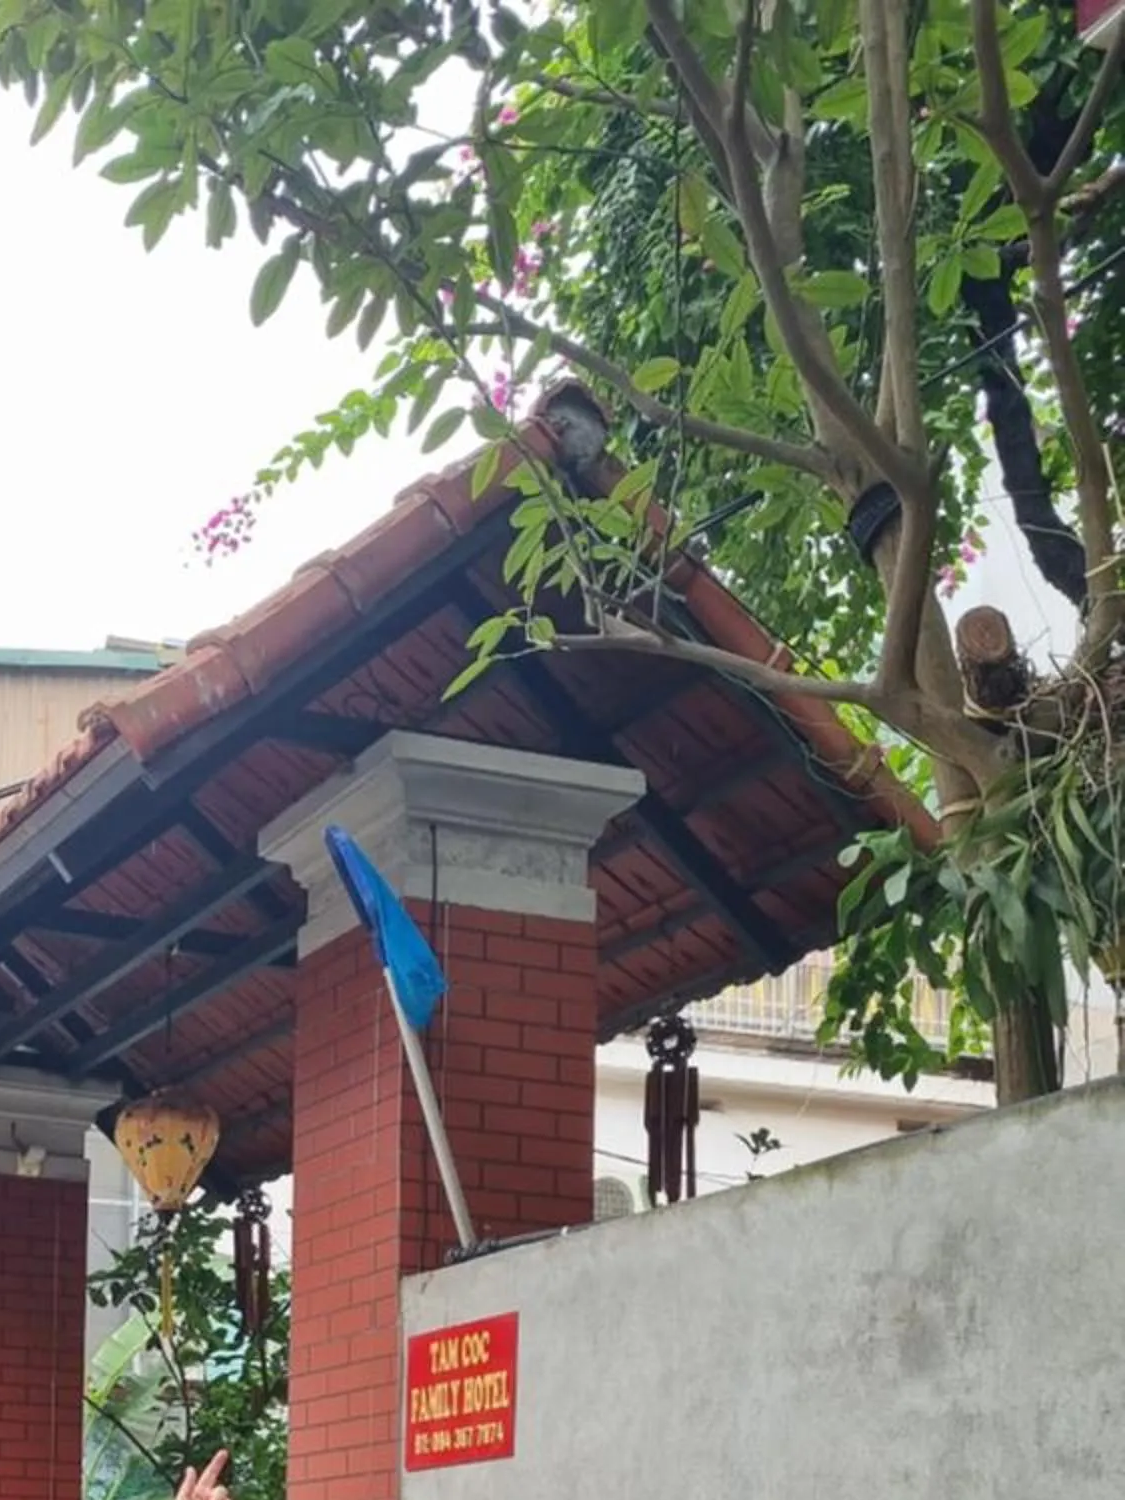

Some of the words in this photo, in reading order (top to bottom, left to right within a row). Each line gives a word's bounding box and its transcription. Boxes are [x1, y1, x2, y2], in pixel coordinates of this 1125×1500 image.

[430, 1336, 459, 1374] TAM
[461, 1330, 490, 1367] COC
[410, 1379, 460, 1424] FAMILY
[462, 1369, 510, 1414] HOTEL
